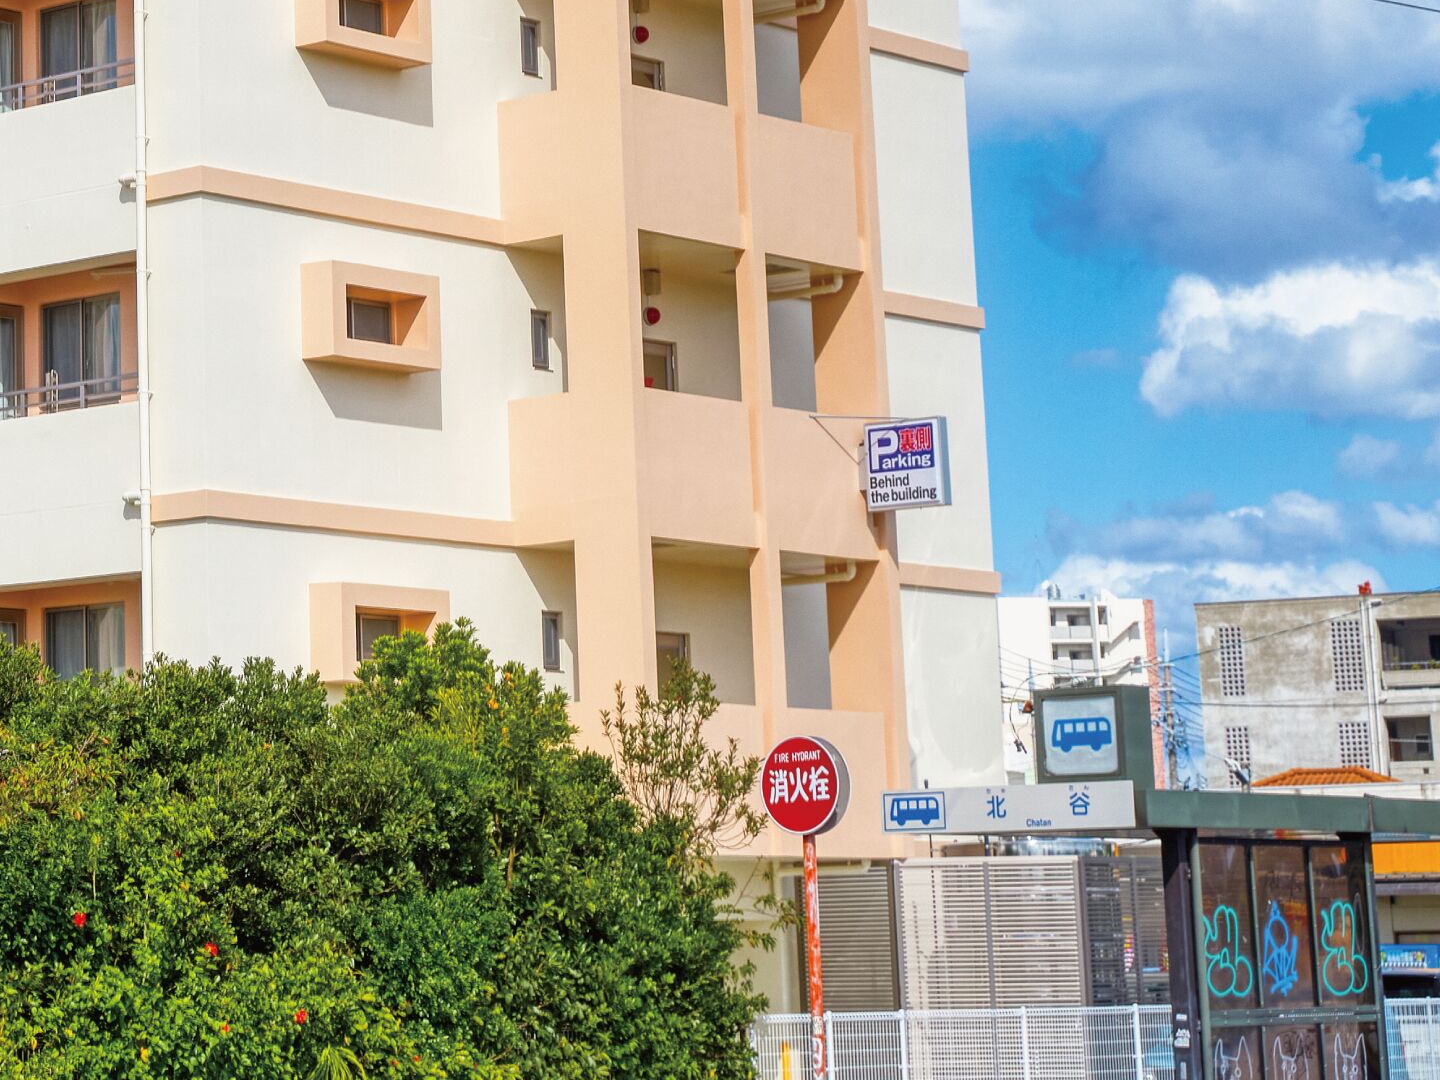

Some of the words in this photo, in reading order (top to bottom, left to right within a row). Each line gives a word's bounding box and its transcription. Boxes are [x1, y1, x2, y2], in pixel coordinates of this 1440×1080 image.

[899, 426, 932, 453] 裏側
[870, 473, 910, 489] Behind
[871, 490, 890, 503] the
[891, 486, 937, 501] building
[774, 752, 789, 764] FIRE
[791, 749, 821, 762] HYDRANT
[769, 765, 830, 804] 消火栓
[1026, 818, 1052, 827] Chatan
